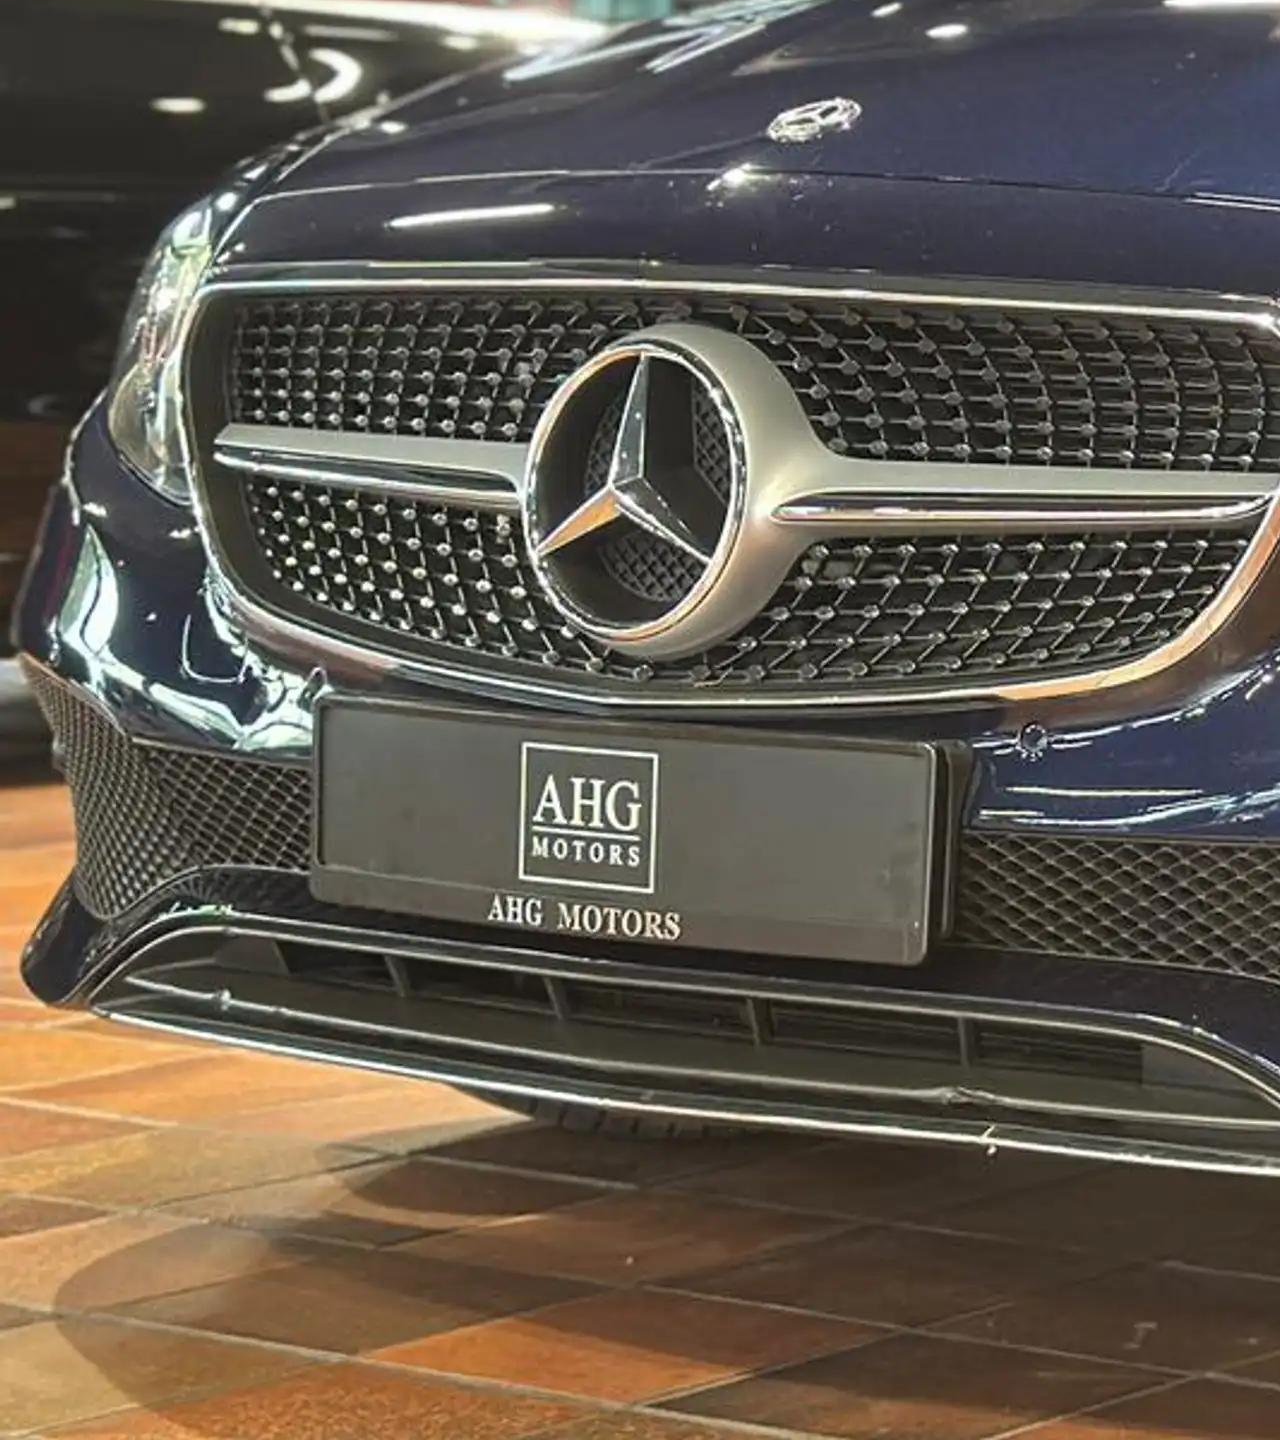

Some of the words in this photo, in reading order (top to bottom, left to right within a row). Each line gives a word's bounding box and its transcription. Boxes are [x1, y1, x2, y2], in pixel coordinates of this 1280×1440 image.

[532, 774, 643, 832] AHG
[532, 836, 641, 867] MOTORS
[487, 894, 543, 926] AHG
[556, 902, 682, 941] MOTORS
